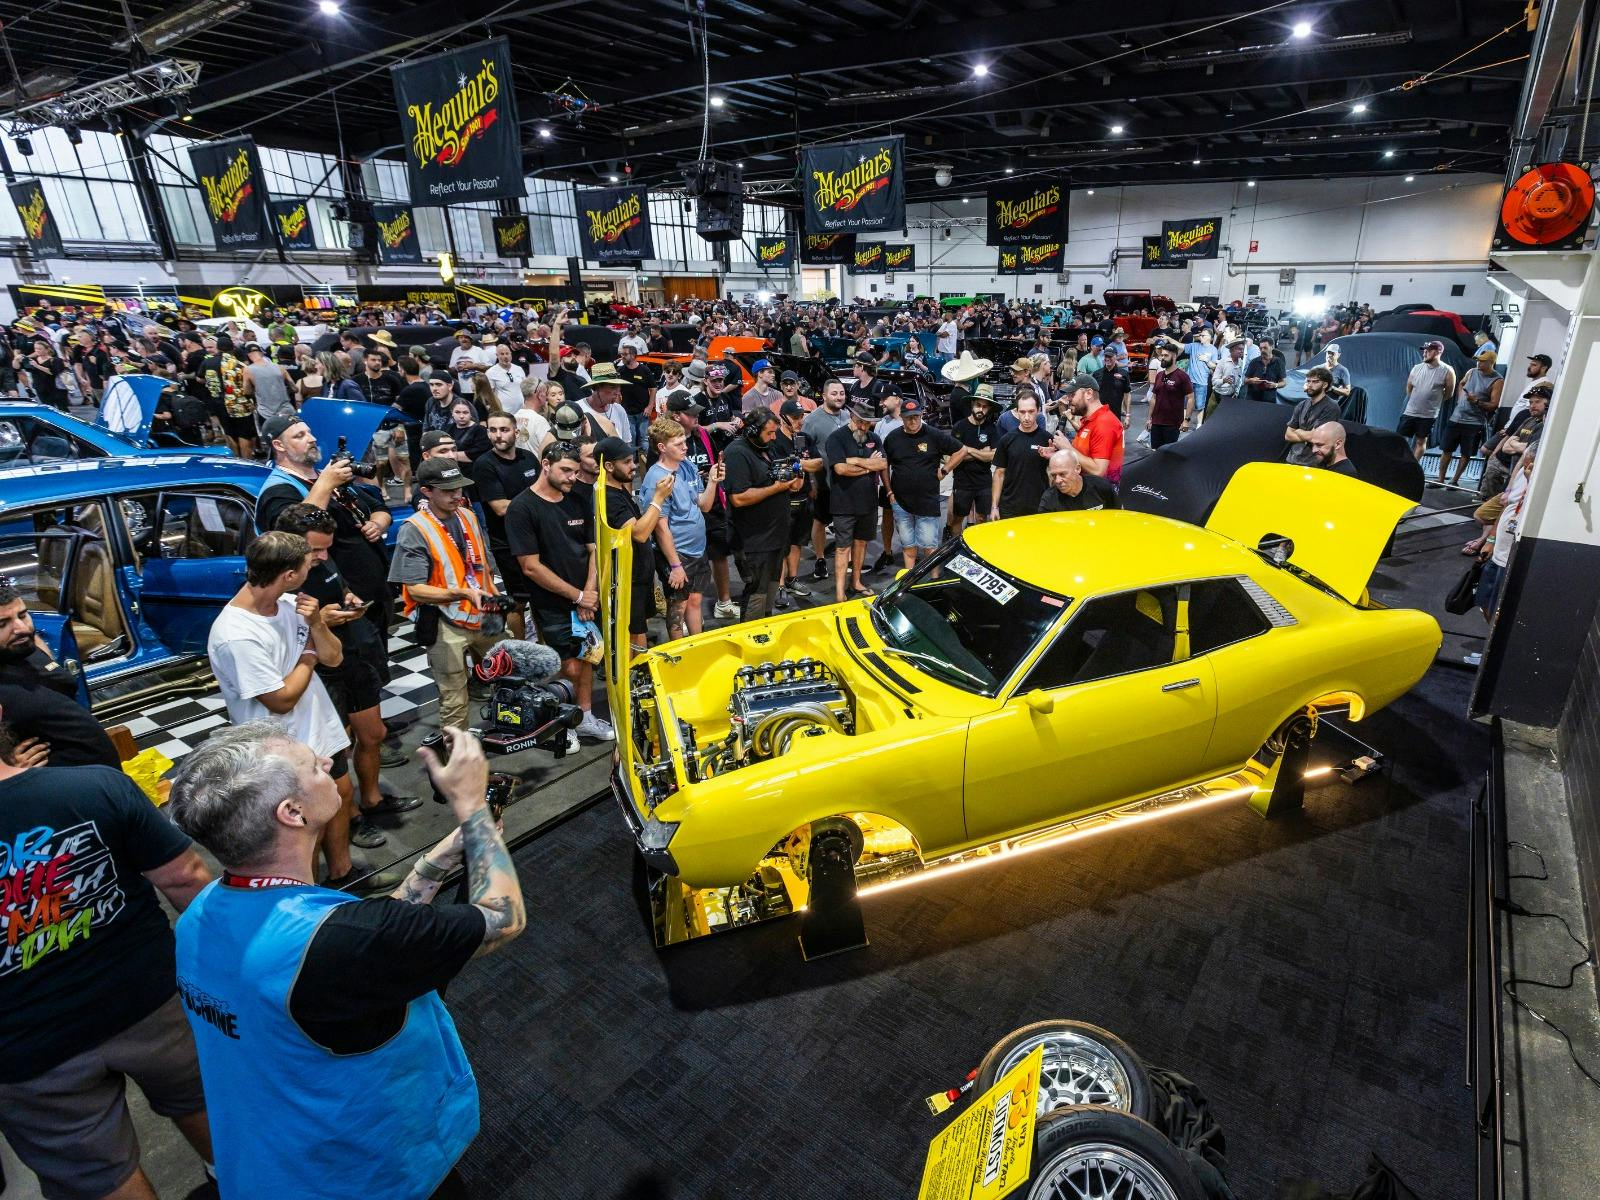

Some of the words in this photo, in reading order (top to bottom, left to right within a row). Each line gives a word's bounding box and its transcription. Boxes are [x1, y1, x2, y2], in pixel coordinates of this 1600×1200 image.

[408, 58, 499, 169] Meguiar's
[430, 182, 455, 198] Reflect
[456, 180, 471, 191] Your
[813, 148, 891, 212] Meguiar's
[586, 192, 640, 243] Meguiar's
[825, 219, 846, 228] Reflect
[848, 218, 860, 226] Your
[995, 185, 1060, 230] Meguiar's
[1167, 221, 1214, 251] Meguiar's
[977, 573, 1007, 595] 1795
[506, 738, 537, 753] RONIN
[985, 1101, 1009, 1178] UTMOST
